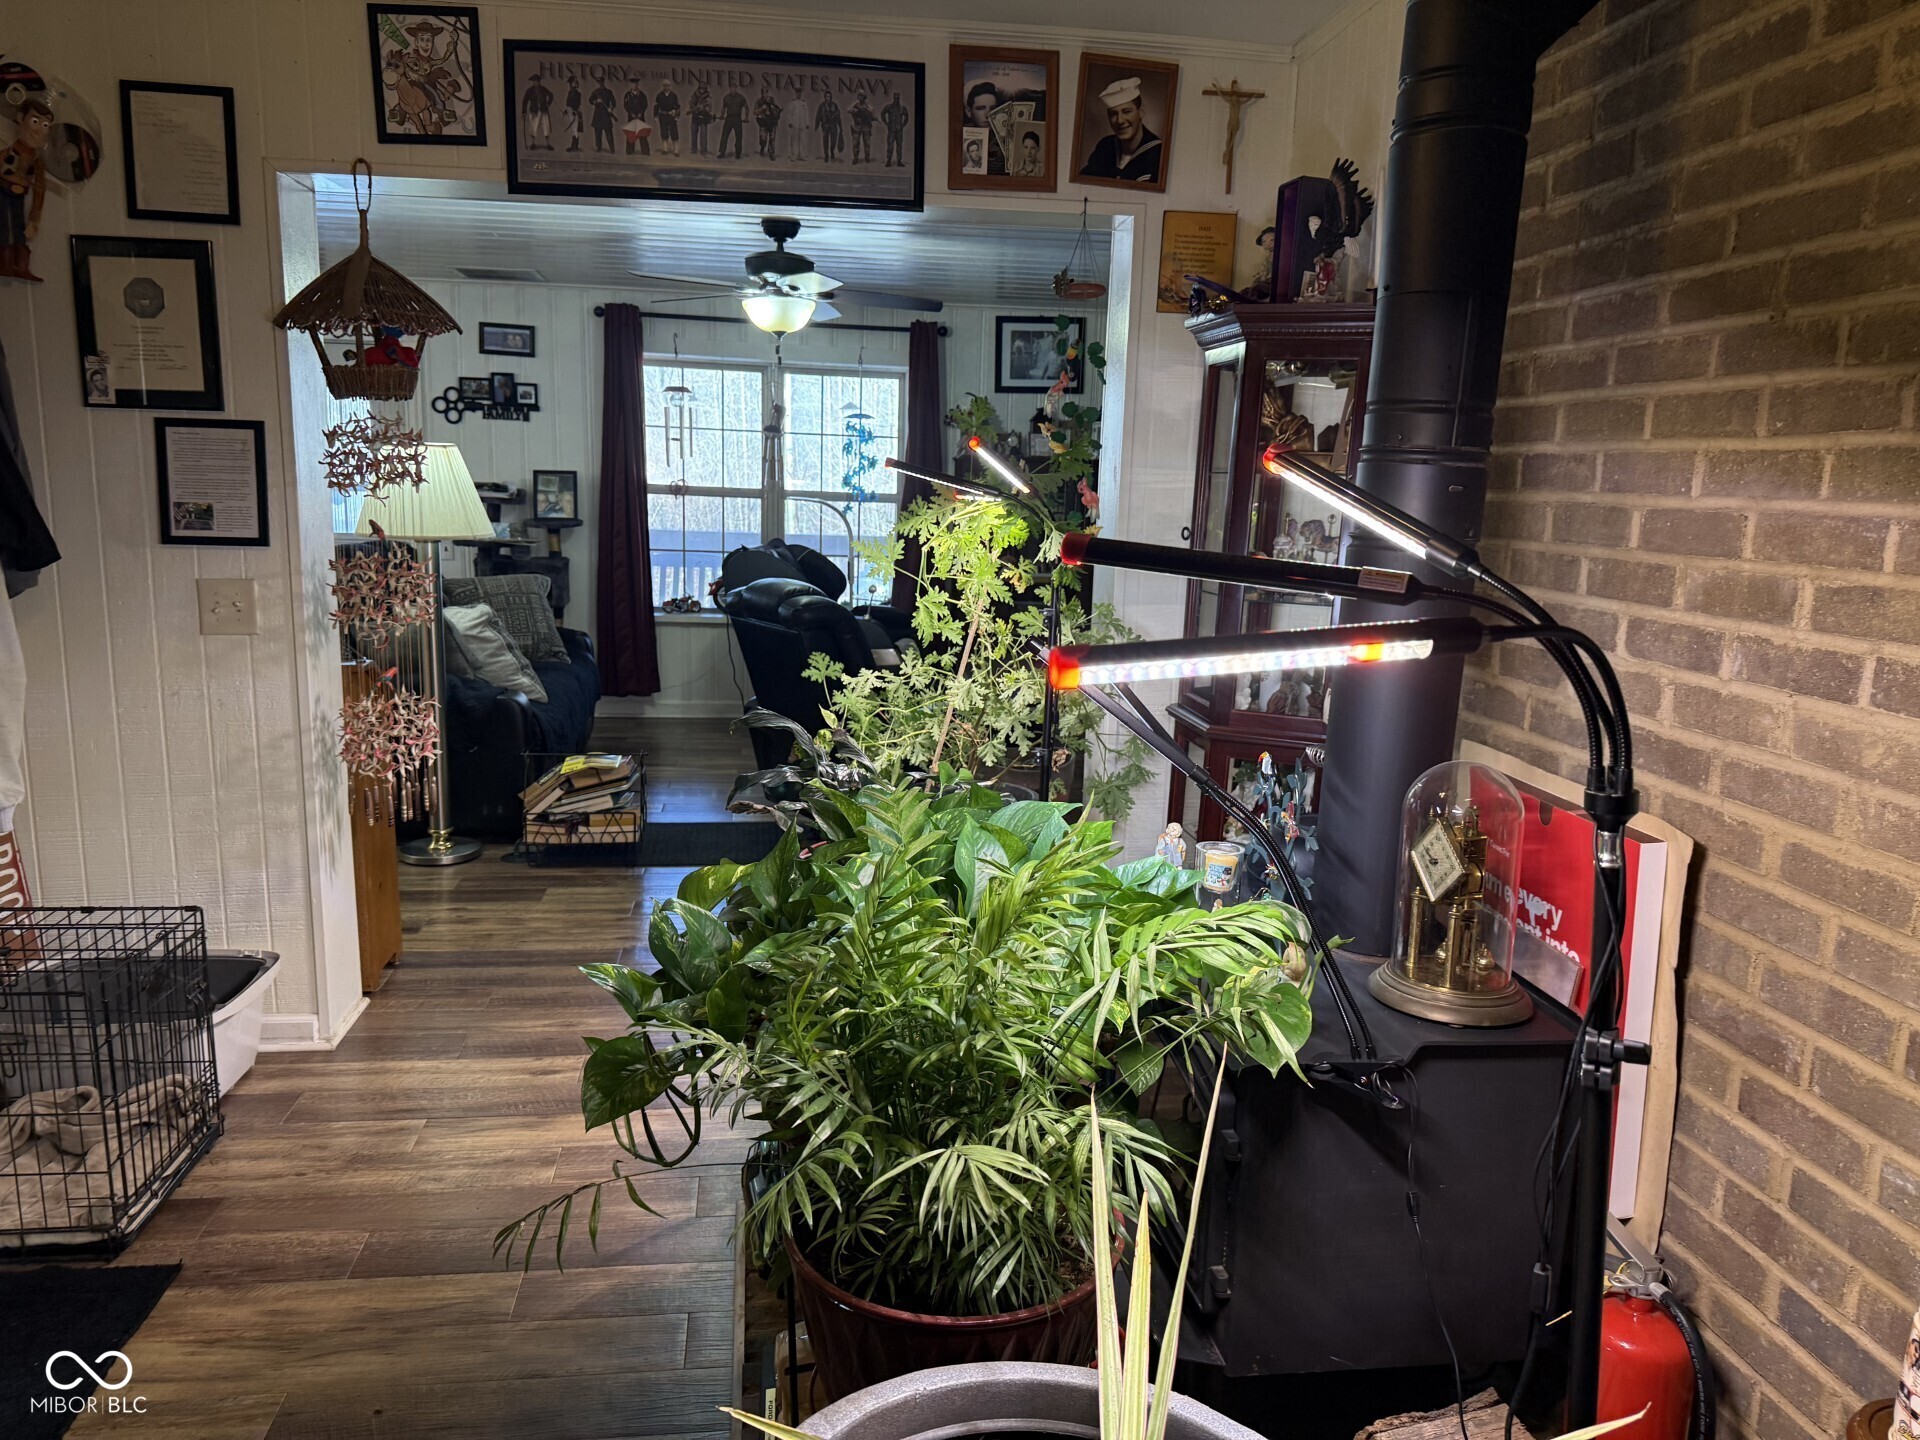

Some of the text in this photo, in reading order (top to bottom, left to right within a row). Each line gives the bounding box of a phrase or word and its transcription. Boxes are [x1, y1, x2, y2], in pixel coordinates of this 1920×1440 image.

[539, 60, 631, 82] HISTORY
[671, 67, 753, 88] UNITED
[761, 72, 833, 92] STATES
[837, 76, 893, 96] NAVY
